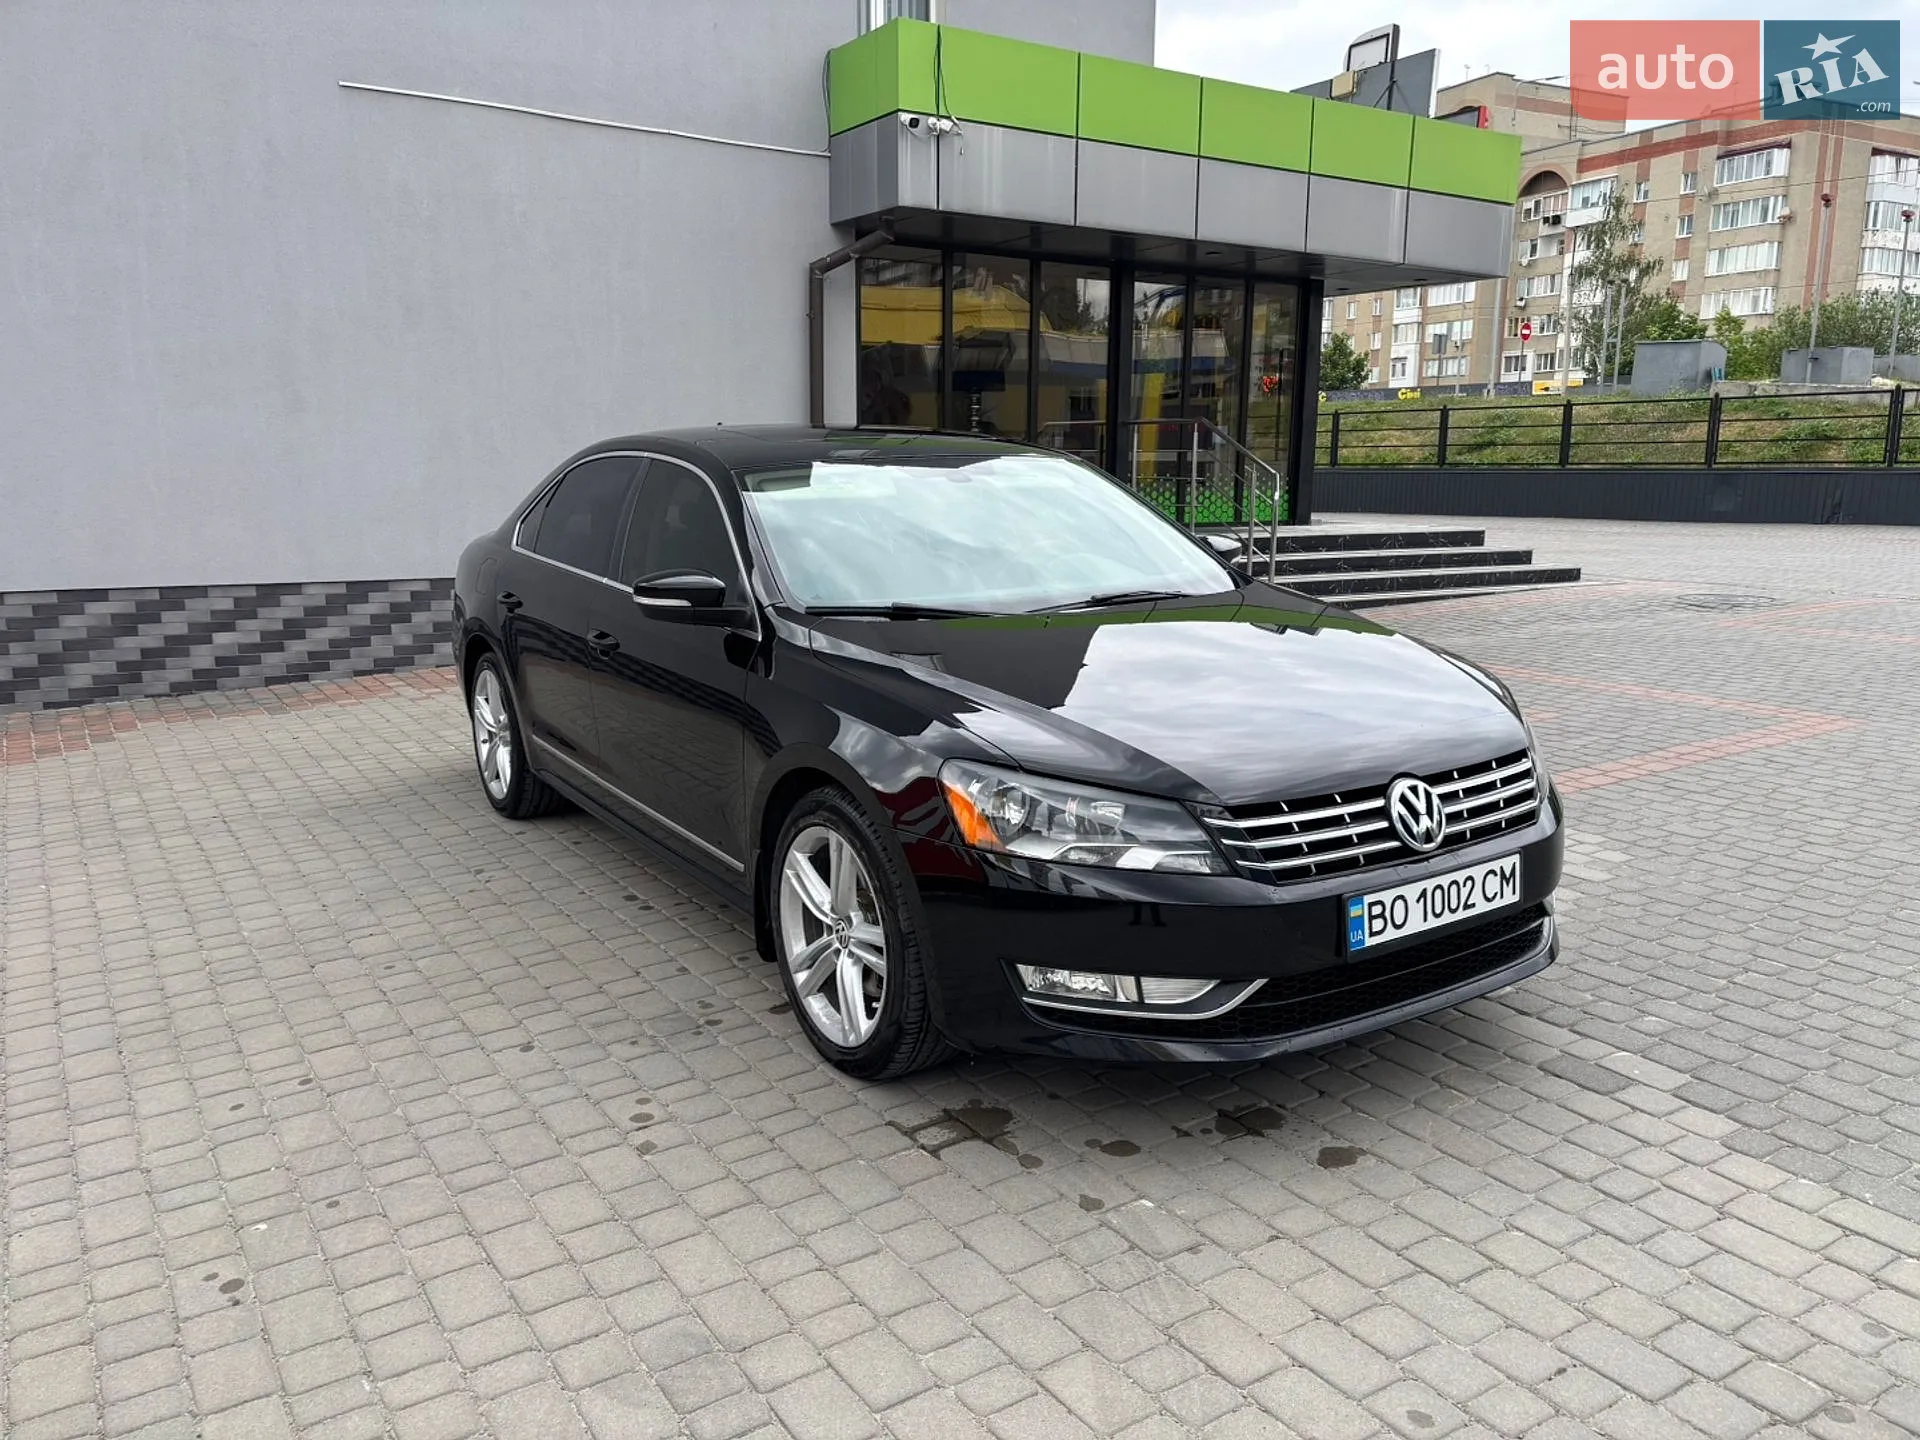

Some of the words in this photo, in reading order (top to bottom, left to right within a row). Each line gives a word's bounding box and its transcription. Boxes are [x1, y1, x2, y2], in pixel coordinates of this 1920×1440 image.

[1393, 780, 1444, 849] VW
[1367, 895, 1409, 939] BO
[1415, 876, 1476, 923] 1002
[1482, 862, 1516, 904] CM
[1350, 929, 1364, 943] UA
